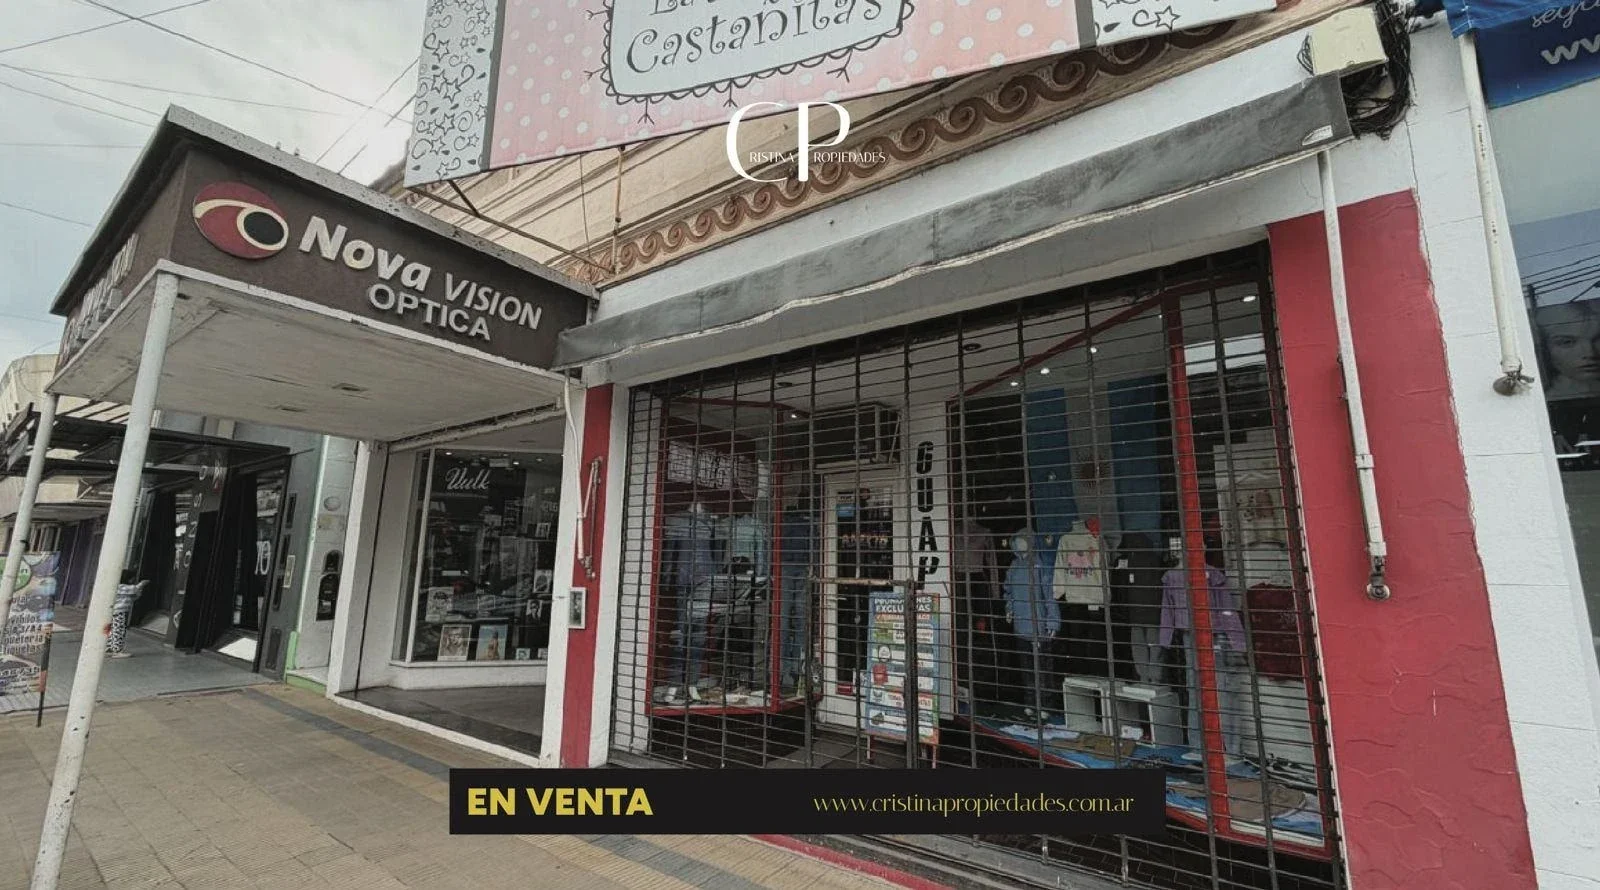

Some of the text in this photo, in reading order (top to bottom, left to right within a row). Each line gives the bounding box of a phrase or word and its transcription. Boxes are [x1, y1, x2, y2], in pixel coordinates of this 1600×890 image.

[299, 215, 543, 330] Nova VISION
[367, 282, 491, 342] OPTICA
